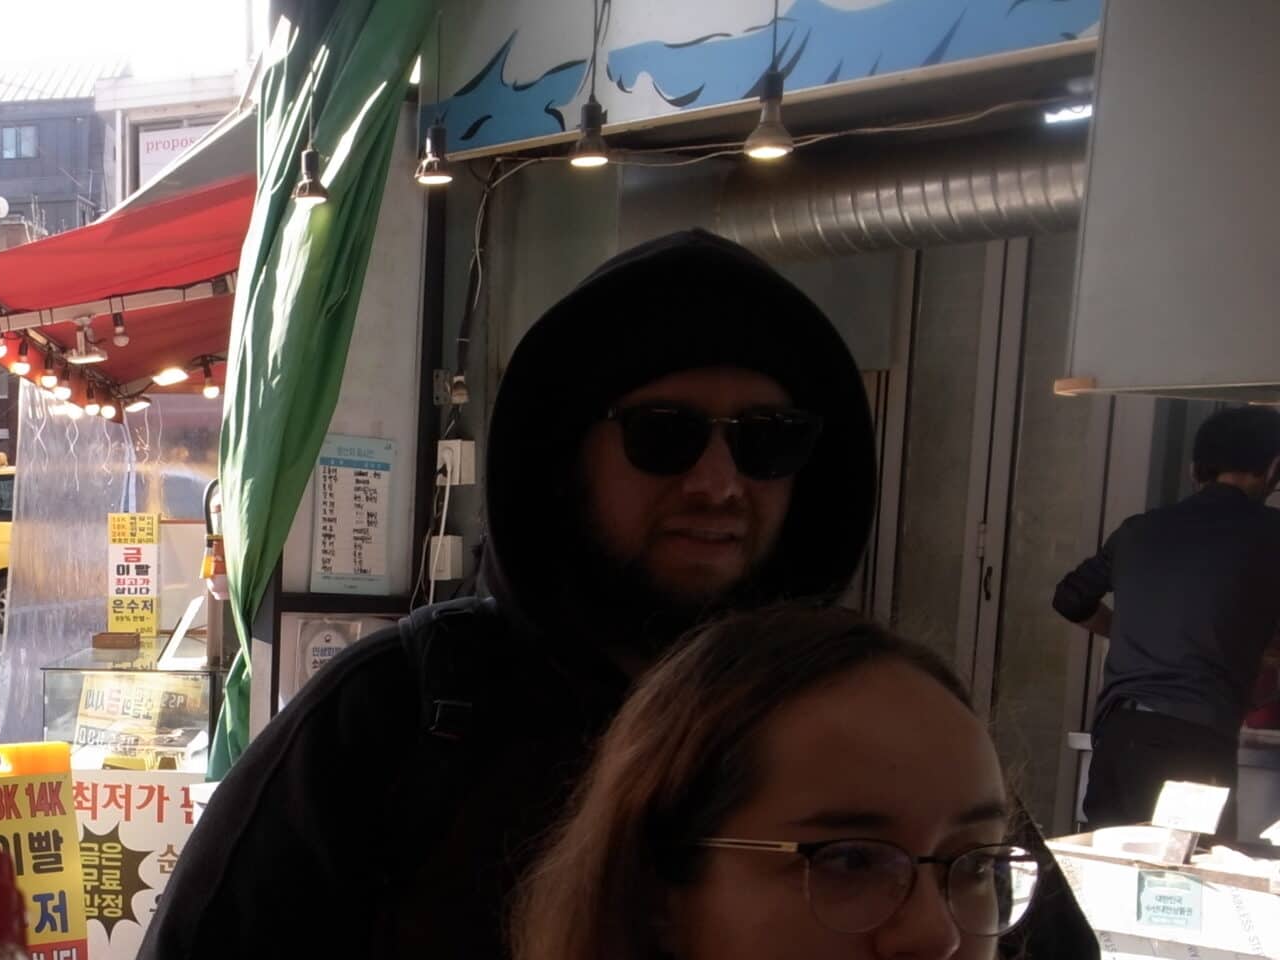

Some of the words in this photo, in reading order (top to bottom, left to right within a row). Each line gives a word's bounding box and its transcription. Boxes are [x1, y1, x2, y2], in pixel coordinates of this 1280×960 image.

[123, 547, 141, 563] 금
[112, 599, 154, 614] 은수저
[25, 780, 67, 818] 14K
[72, 781, 170, 823] 최저가
[80, 842, 122, 866] 금은
[82, 868, 122, 891] 무료
[85, 893, 123, 918] 감정
